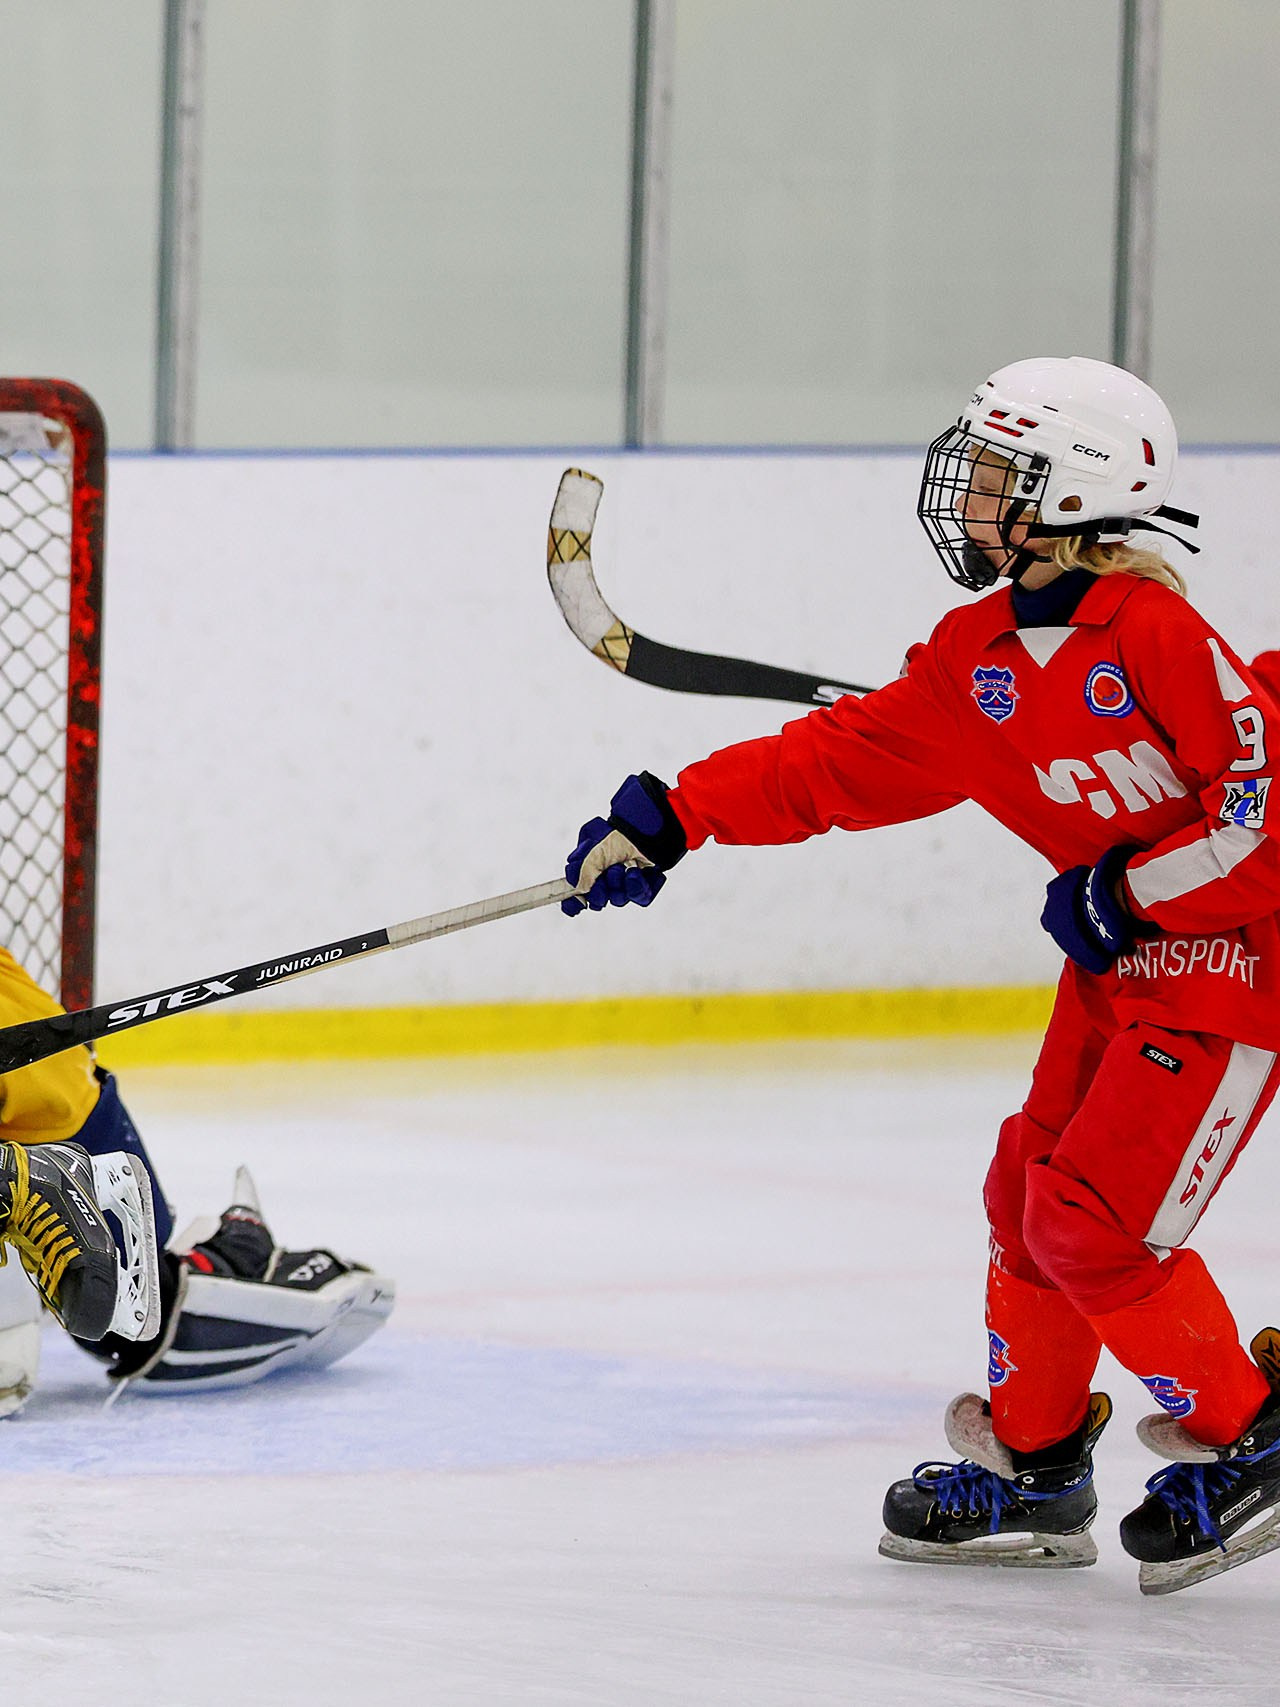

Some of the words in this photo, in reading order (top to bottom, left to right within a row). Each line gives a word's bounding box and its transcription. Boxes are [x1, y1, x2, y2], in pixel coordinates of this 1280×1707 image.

[1071, 443, 1111, 462] CCM
[1229, 705, 1268, 773] 9
[107, 974, 239, 1028] STEX
[255, 947, 343, 982] JUNIRAID
[1146, 1048, 1177, 1069] STEX
[1179, 1106, 1237, 1209] STEX
[66, 1187, 98, 1227] CCM
[1223, 1492, 1258, 1522] BAUER
